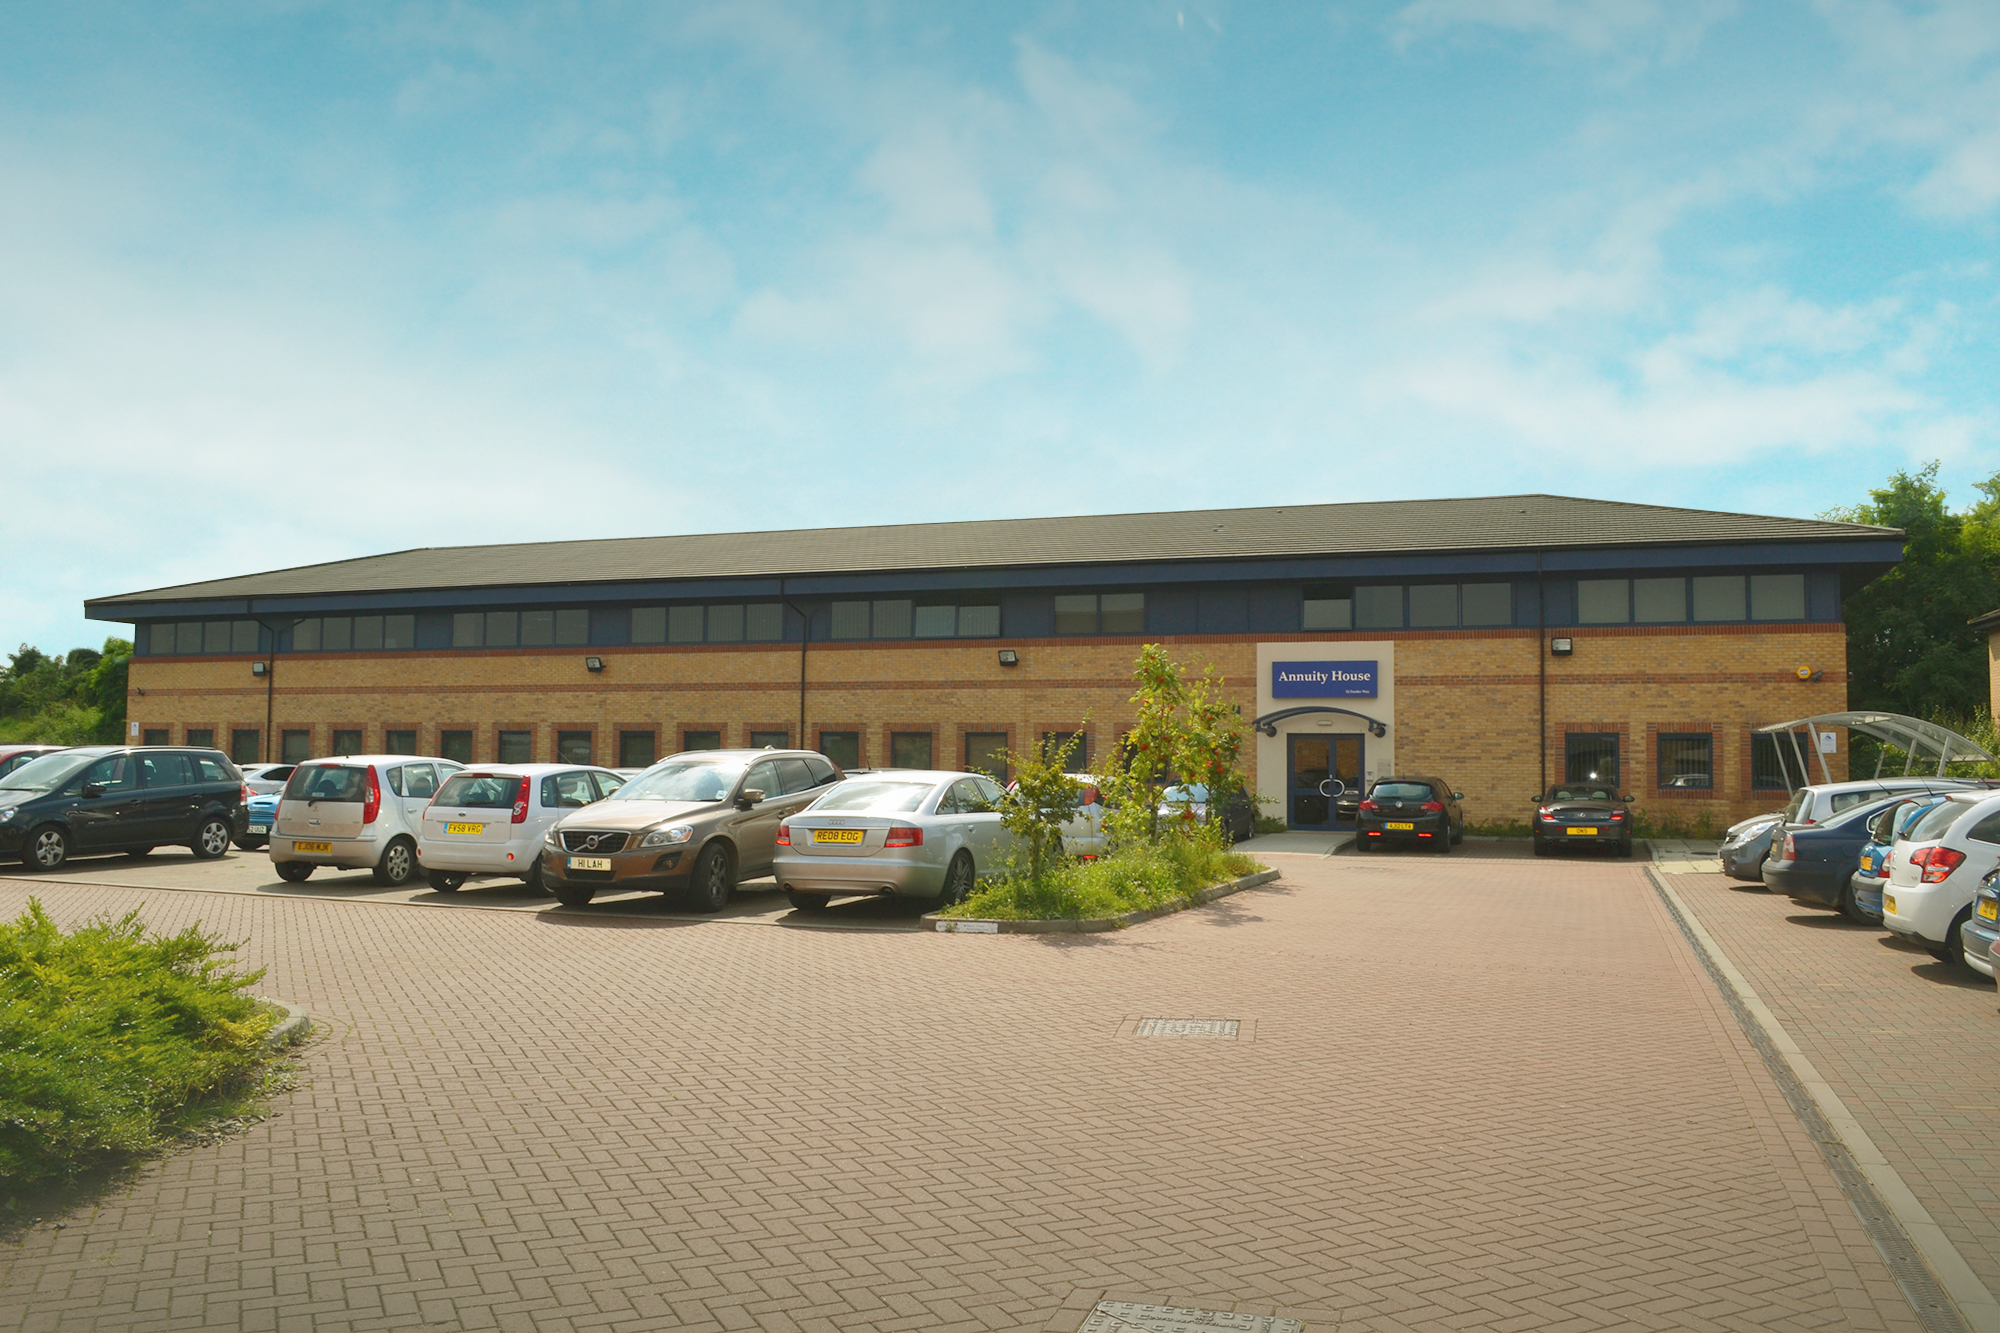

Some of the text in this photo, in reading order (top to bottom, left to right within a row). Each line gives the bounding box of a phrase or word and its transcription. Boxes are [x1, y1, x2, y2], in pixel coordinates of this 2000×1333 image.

[1279, 671, 1371, 684] Annuity House
[448, 823, 481, 833] FV58 VRG
[816, 831, 859, 841] RE08 EOG
